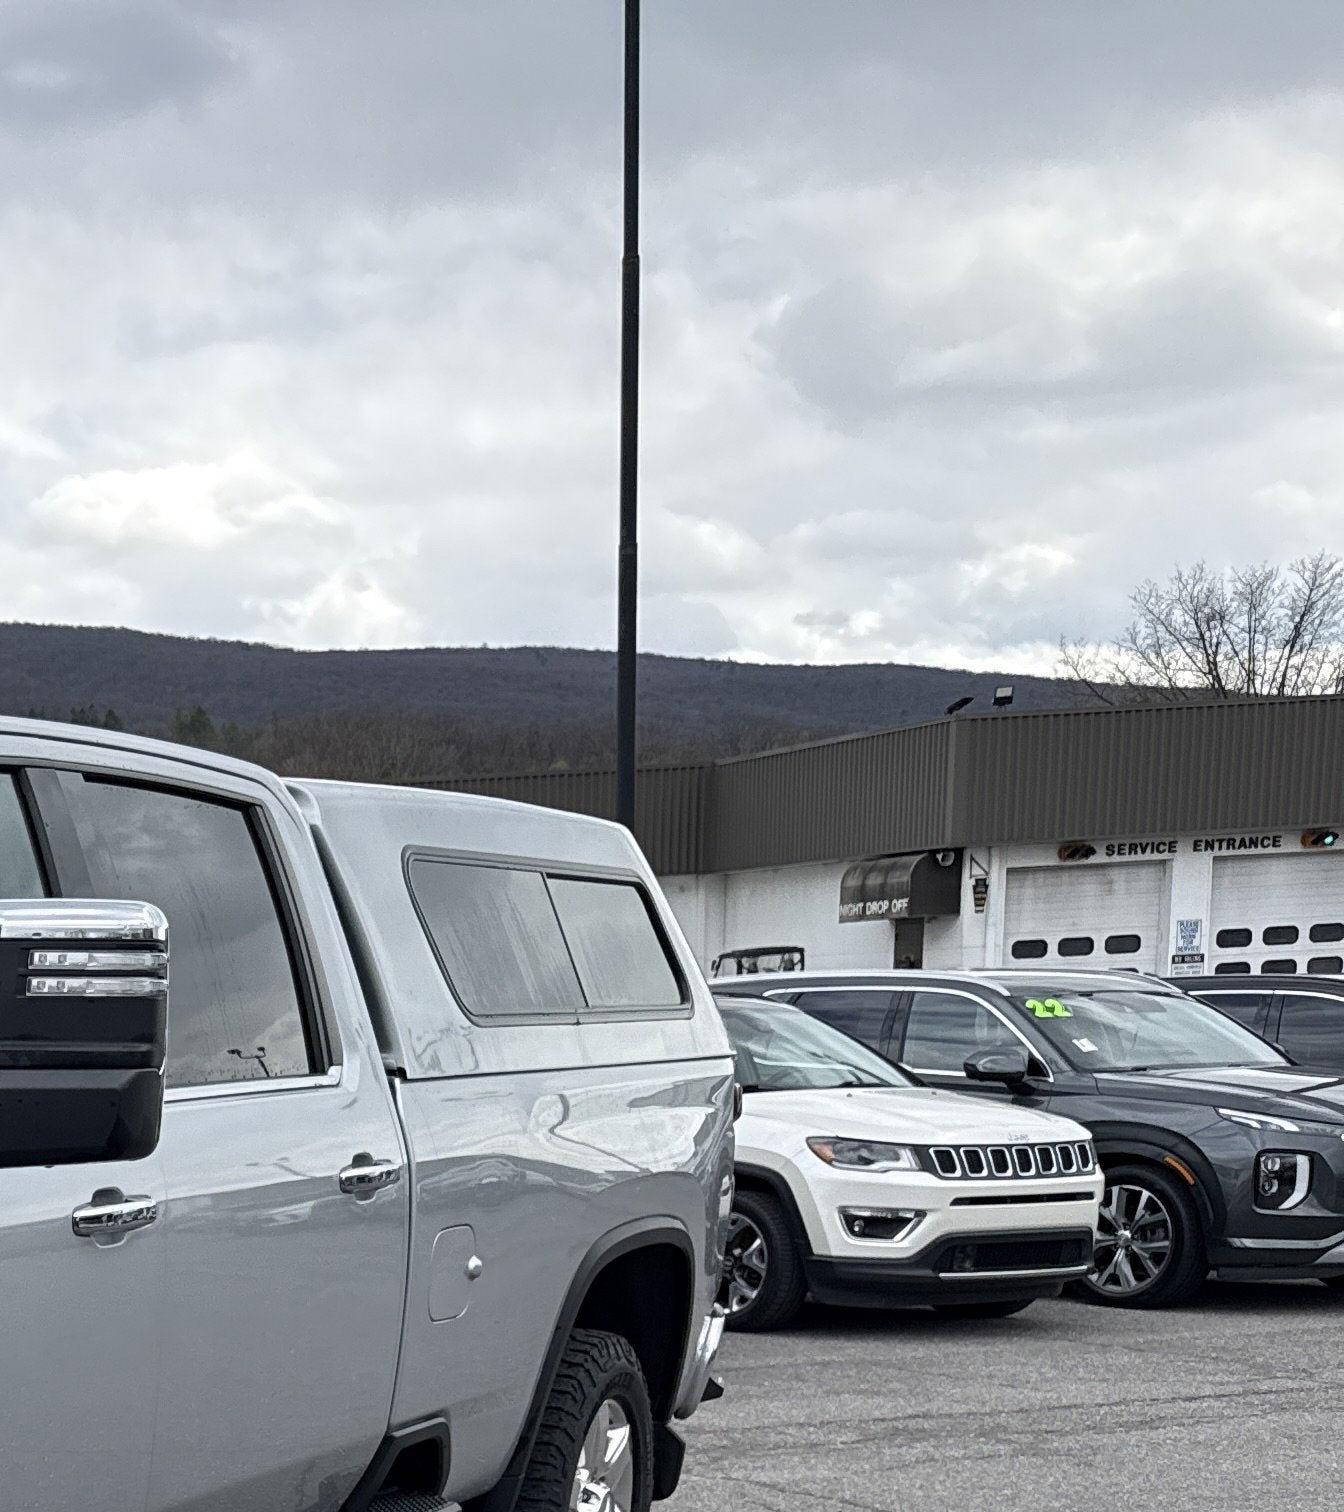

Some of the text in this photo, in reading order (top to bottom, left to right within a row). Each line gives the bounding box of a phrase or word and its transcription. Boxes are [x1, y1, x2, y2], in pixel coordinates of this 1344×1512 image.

[1105, 835, 1282, 857] SERVICE ENTRANCE
[839, 897, 910, 917] NIGHT DROP OFF
[1025, 998, 1073, 1018] 22
